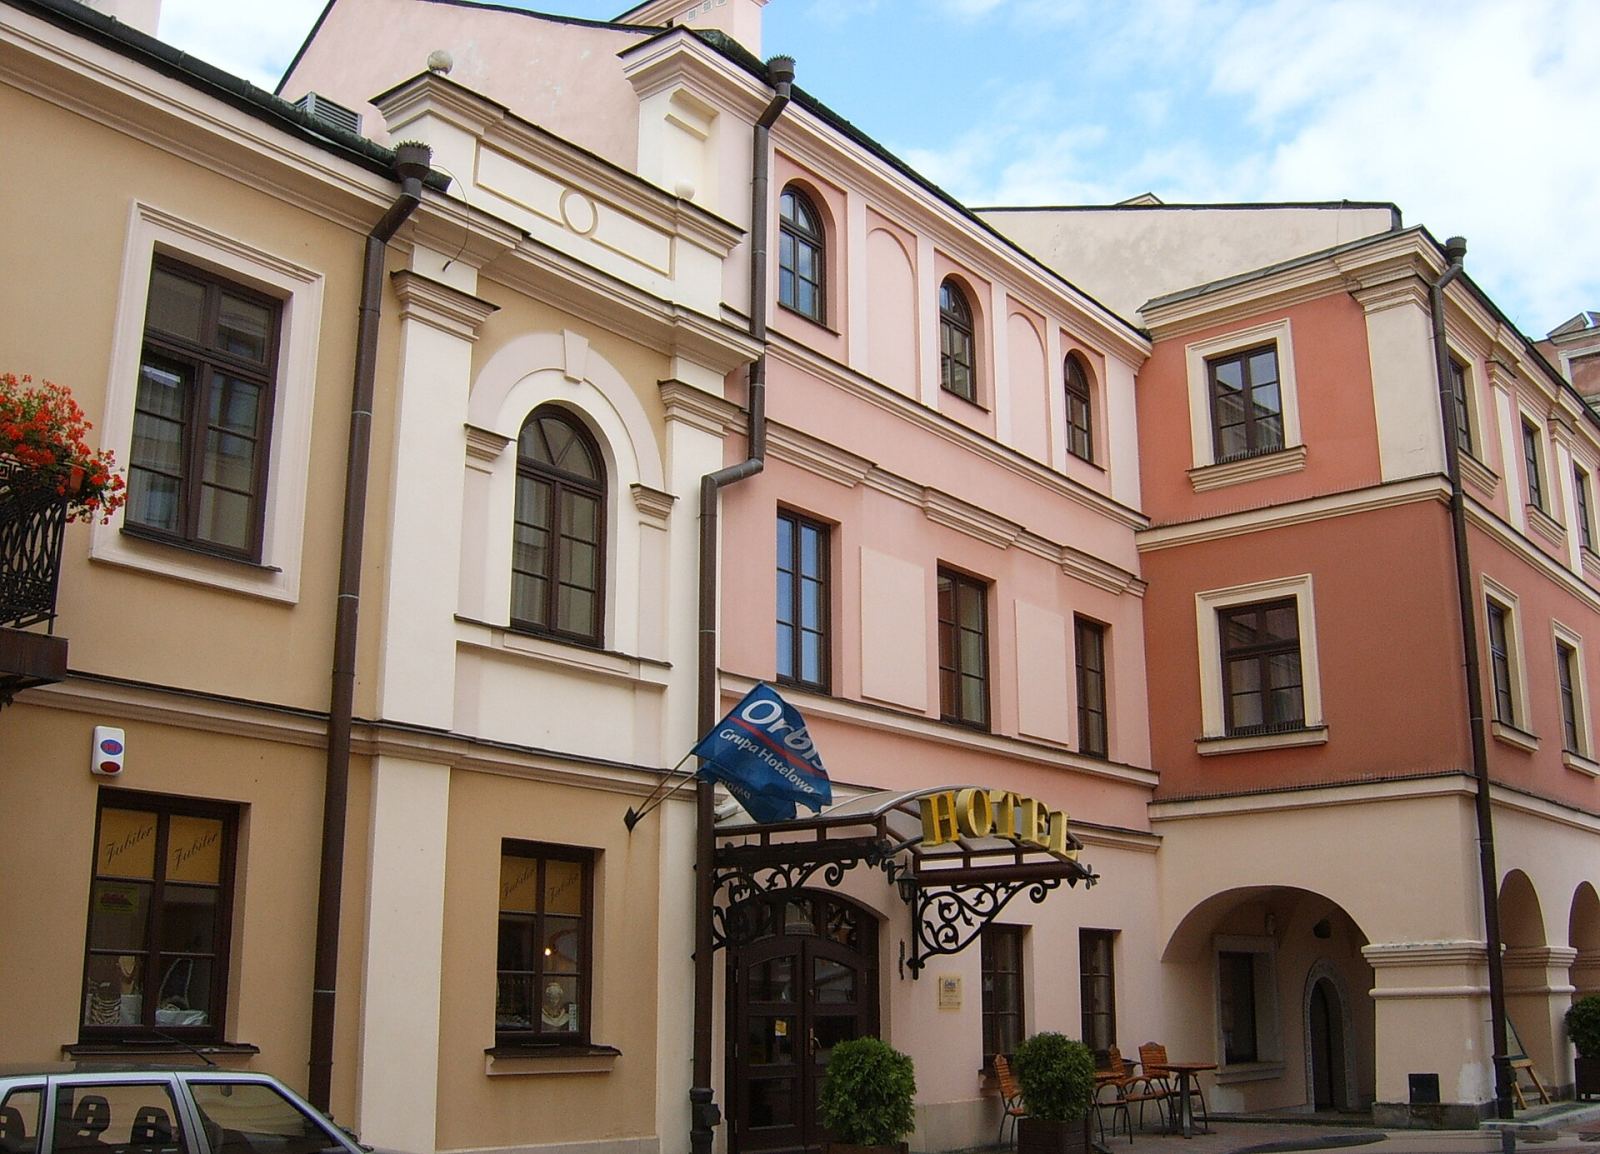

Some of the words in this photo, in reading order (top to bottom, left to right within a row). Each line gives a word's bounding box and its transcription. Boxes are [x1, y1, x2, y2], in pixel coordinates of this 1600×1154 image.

[719, 728, 760, 754] Grupa
[758, 747, 815, 794] Hotelowa
[915, 788, 1079, 862] HOTEL
